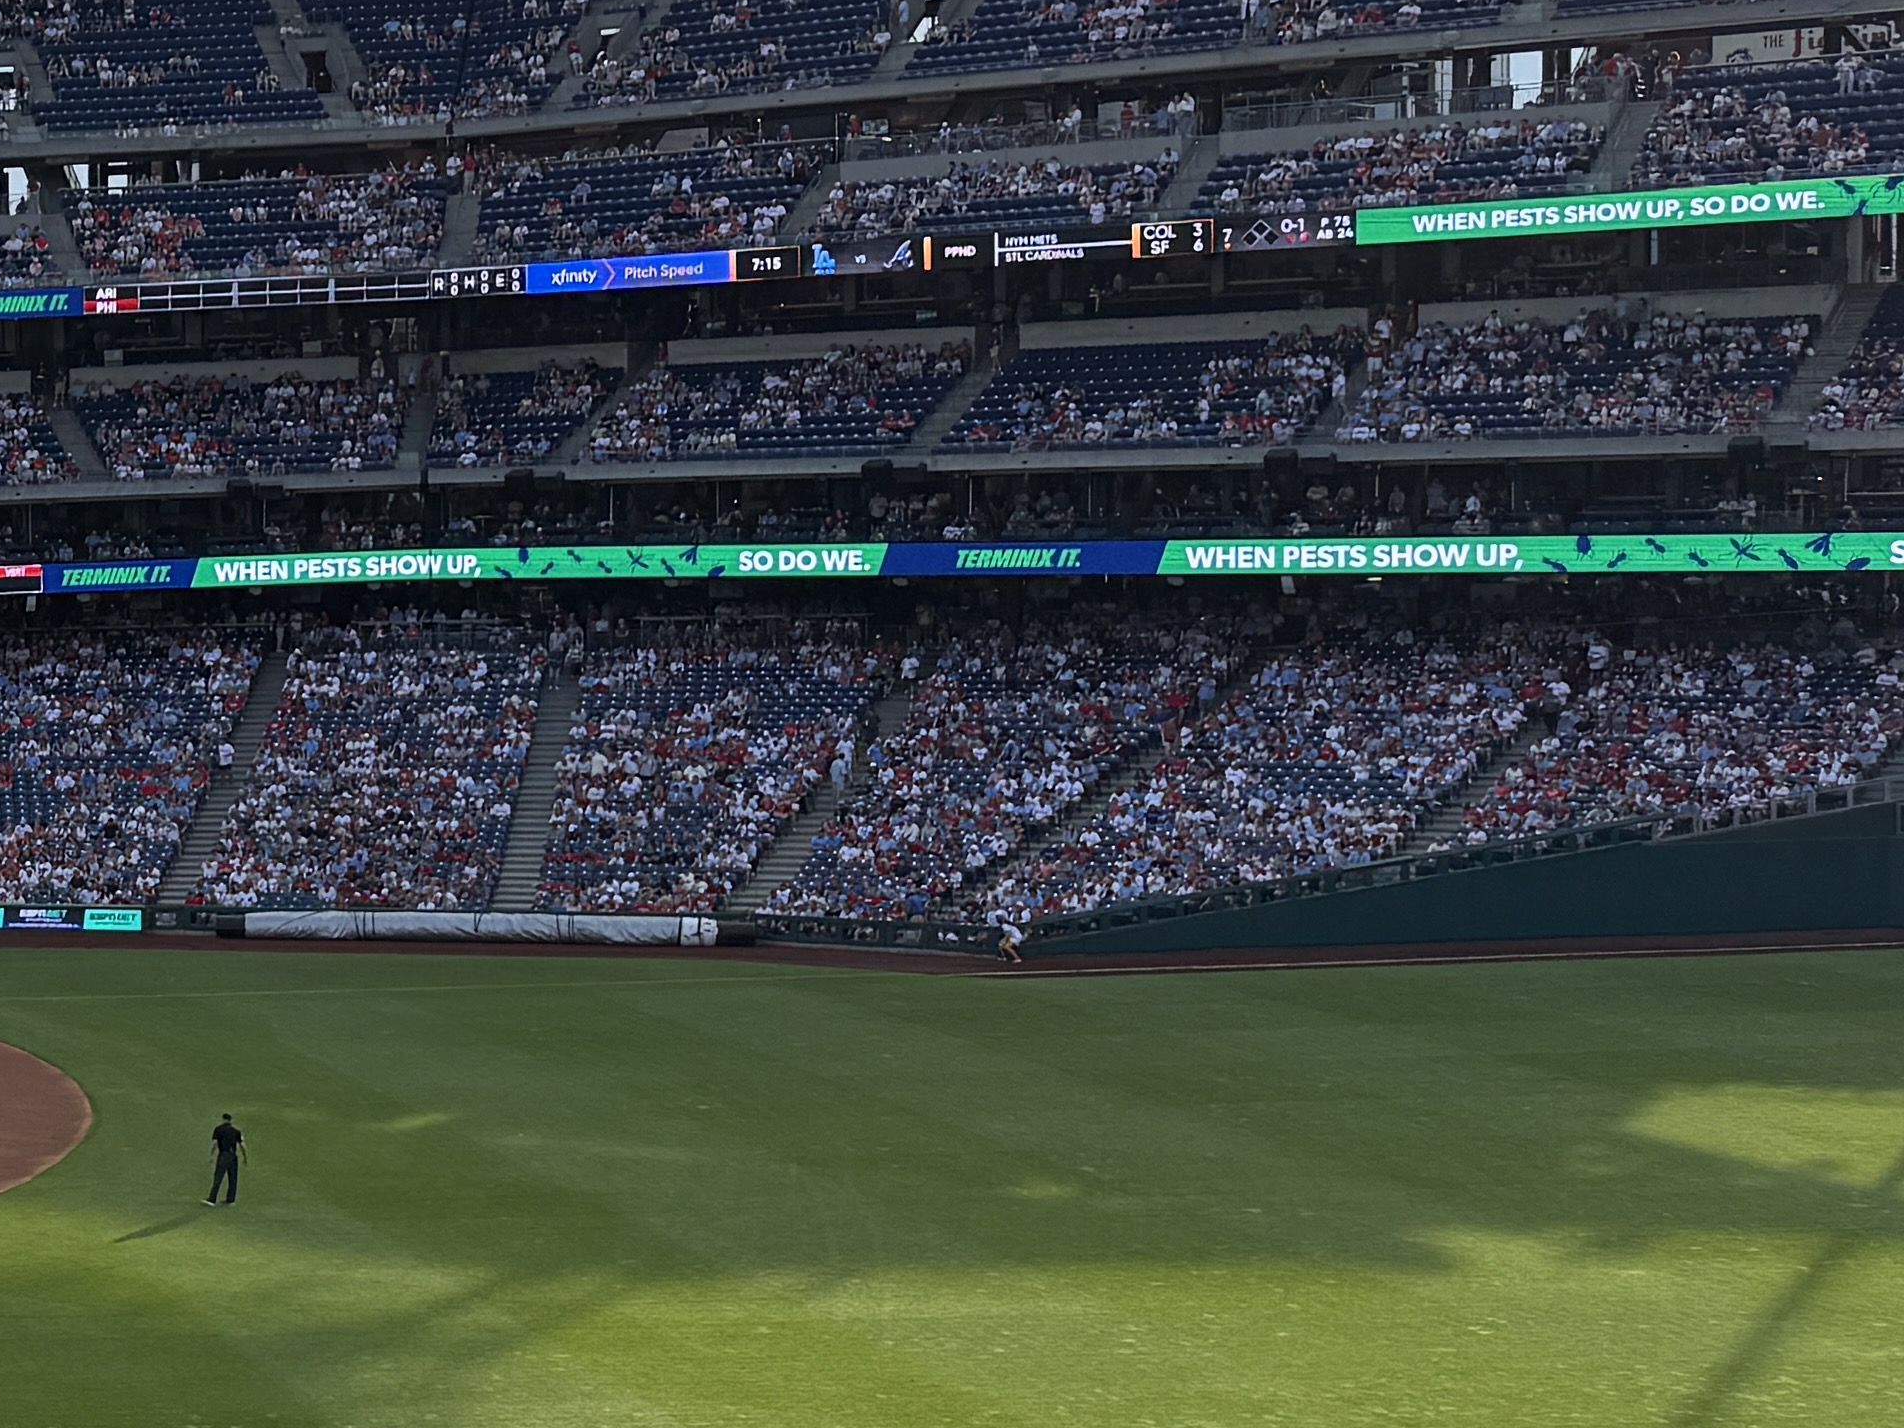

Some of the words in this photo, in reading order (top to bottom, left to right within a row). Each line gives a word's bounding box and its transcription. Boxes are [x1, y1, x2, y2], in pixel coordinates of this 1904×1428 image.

[1763, 34, 1784, 49] THE
[1412, 211, 1485, 233] WHEN
[1491, 206, 1560, 229] PESTS
[1564, 202, 1642, 225] SHOW
[1647, 198, 1684, 221] UP,
[1690, 197, 1725, 217] SO
[1730, 194, 1770, 214] DO
[1775, 190, 1825, 211] WE.
[1281, 218, 1305, 234] 0-1
[1321, 217, 1329, 228] P
[1030, 234, 1058, 246] METS
[1143, 225, 1177, 241] COL
[1193, 223, 1203, 237] 3
[1222, 229, 1233, 243] 7
[1316, 229, 1333, 240] AB
[1150, 241, 1170, 255] SF
[1193, 239, 1204, 252] 6
[1005, 251, 1023, 263] STL
[1025, 248, 1084, 262] CARDINALS
[751, 257, 782, 271] 7:15
[551, 268, 598, 285] xfinity
[625, 264, 658, 280] Pitch
[660, 262, 704, 279] Speed
[434, 279, 444, 290] R
[464, 277, 475, 289] H
[496, 275, 505, 287] E
[96, 288, 117, 300] ARI
[48, 294, 68, 311] IT.
[96, 302, 117, 314] PHI
[739, 550, 773, 571] SO
[779, 550, 816, 571] DO
[821, 550, 871, 571] WE.
[956, 549, 1055, 569] TERMINIX
[1056, 548, 1081, 568] IT.
[1185, 546, 1275, 569] WHEN
[1283, 545, 1367, 568] PESTS
[1372, 544, 1469, 568] SHOW
[1476, 544, 1524, 571] UP,
[61, 565, 147, 587] TERMINIX
[149, 565, 171, 583] IT.
[214, 561, 288, 582] WHEN
[294, 558, 362, 579] PESTS
[365, 555, 442, 577] SHOW
[447, 554, 481, 577] UP,
